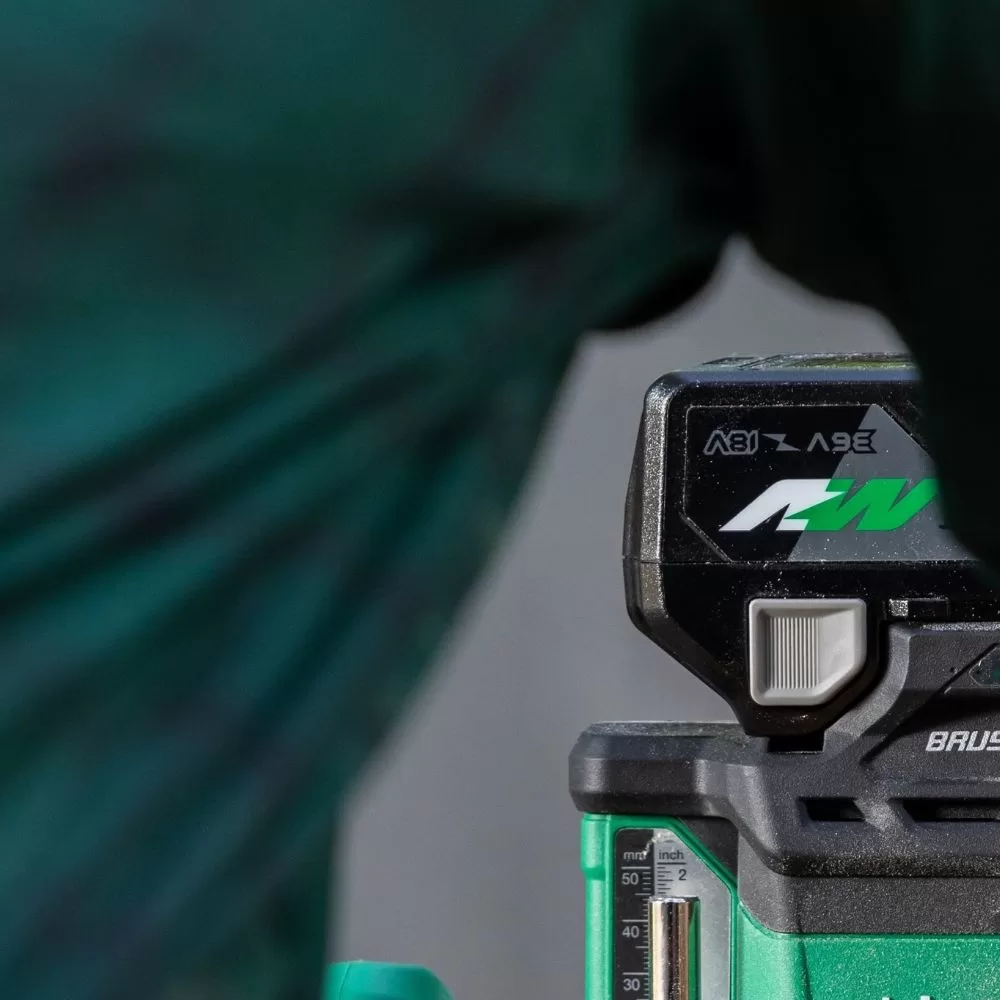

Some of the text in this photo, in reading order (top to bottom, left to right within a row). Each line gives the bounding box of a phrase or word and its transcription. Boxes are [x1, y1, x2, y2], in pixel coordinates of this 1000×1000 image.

[703, 429, 877, 456] 36V 18V
[659, 850, 684, 860] inch
[621, 872, 639, 885] 50
[678, 869, 687, 881] 2
[621, 925, 640, 938] 40
[623, 978, 641, 992] 30
